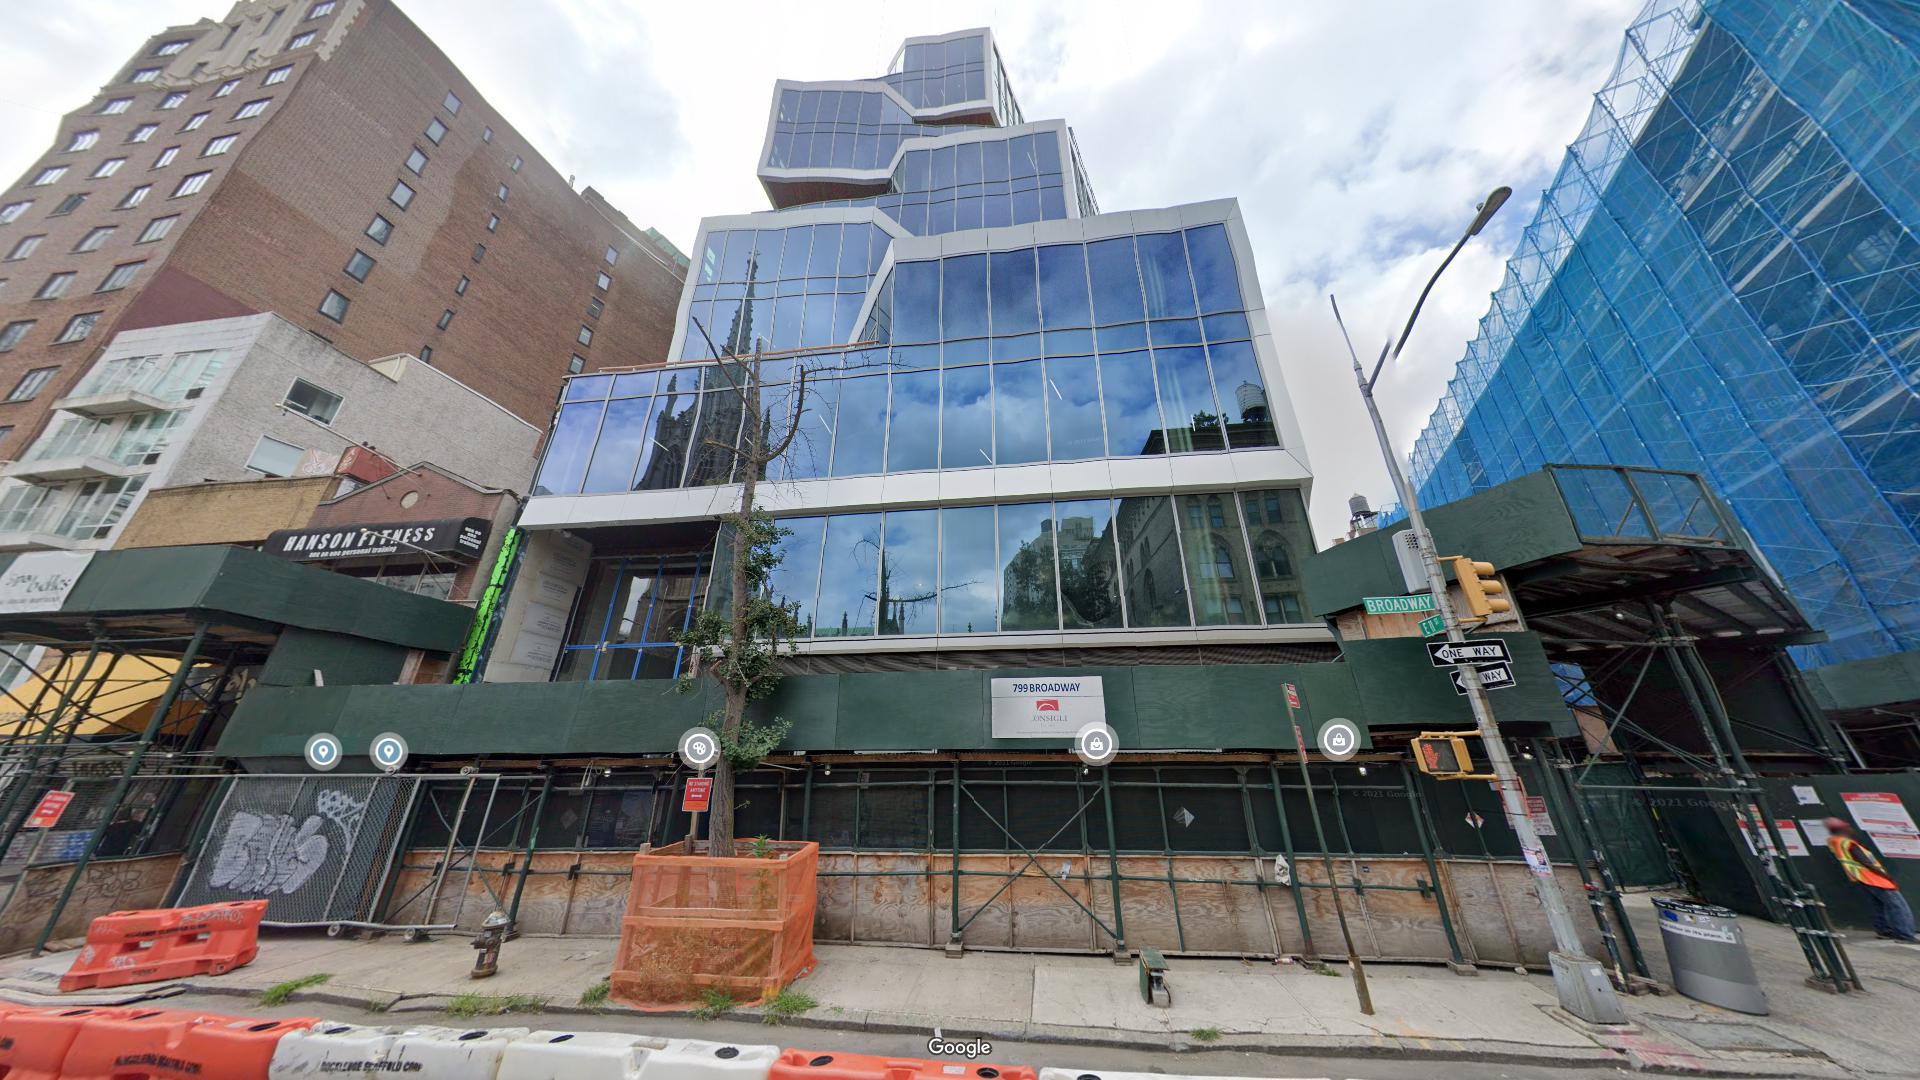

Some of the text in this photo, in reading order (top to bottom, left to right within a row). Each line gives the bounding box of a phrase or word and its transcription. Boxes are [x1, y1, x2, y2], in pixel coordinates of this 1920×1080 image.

[283, 527, 436, 551] HANSON FITNESS
[341, 547, 372, 556] personal
[371, 546, 398, 554] training
[1367, 596, 1433, 612] BROADWAY
[1422, 622, 1431, 634] E
[1429, 620, 1437, 632] 11
[1441, 647, 1498, 659] ONE WAY
[1483, 669, 1504, 682] WAY
[1012, 683, 1081, 693] 799 BROADWAY
